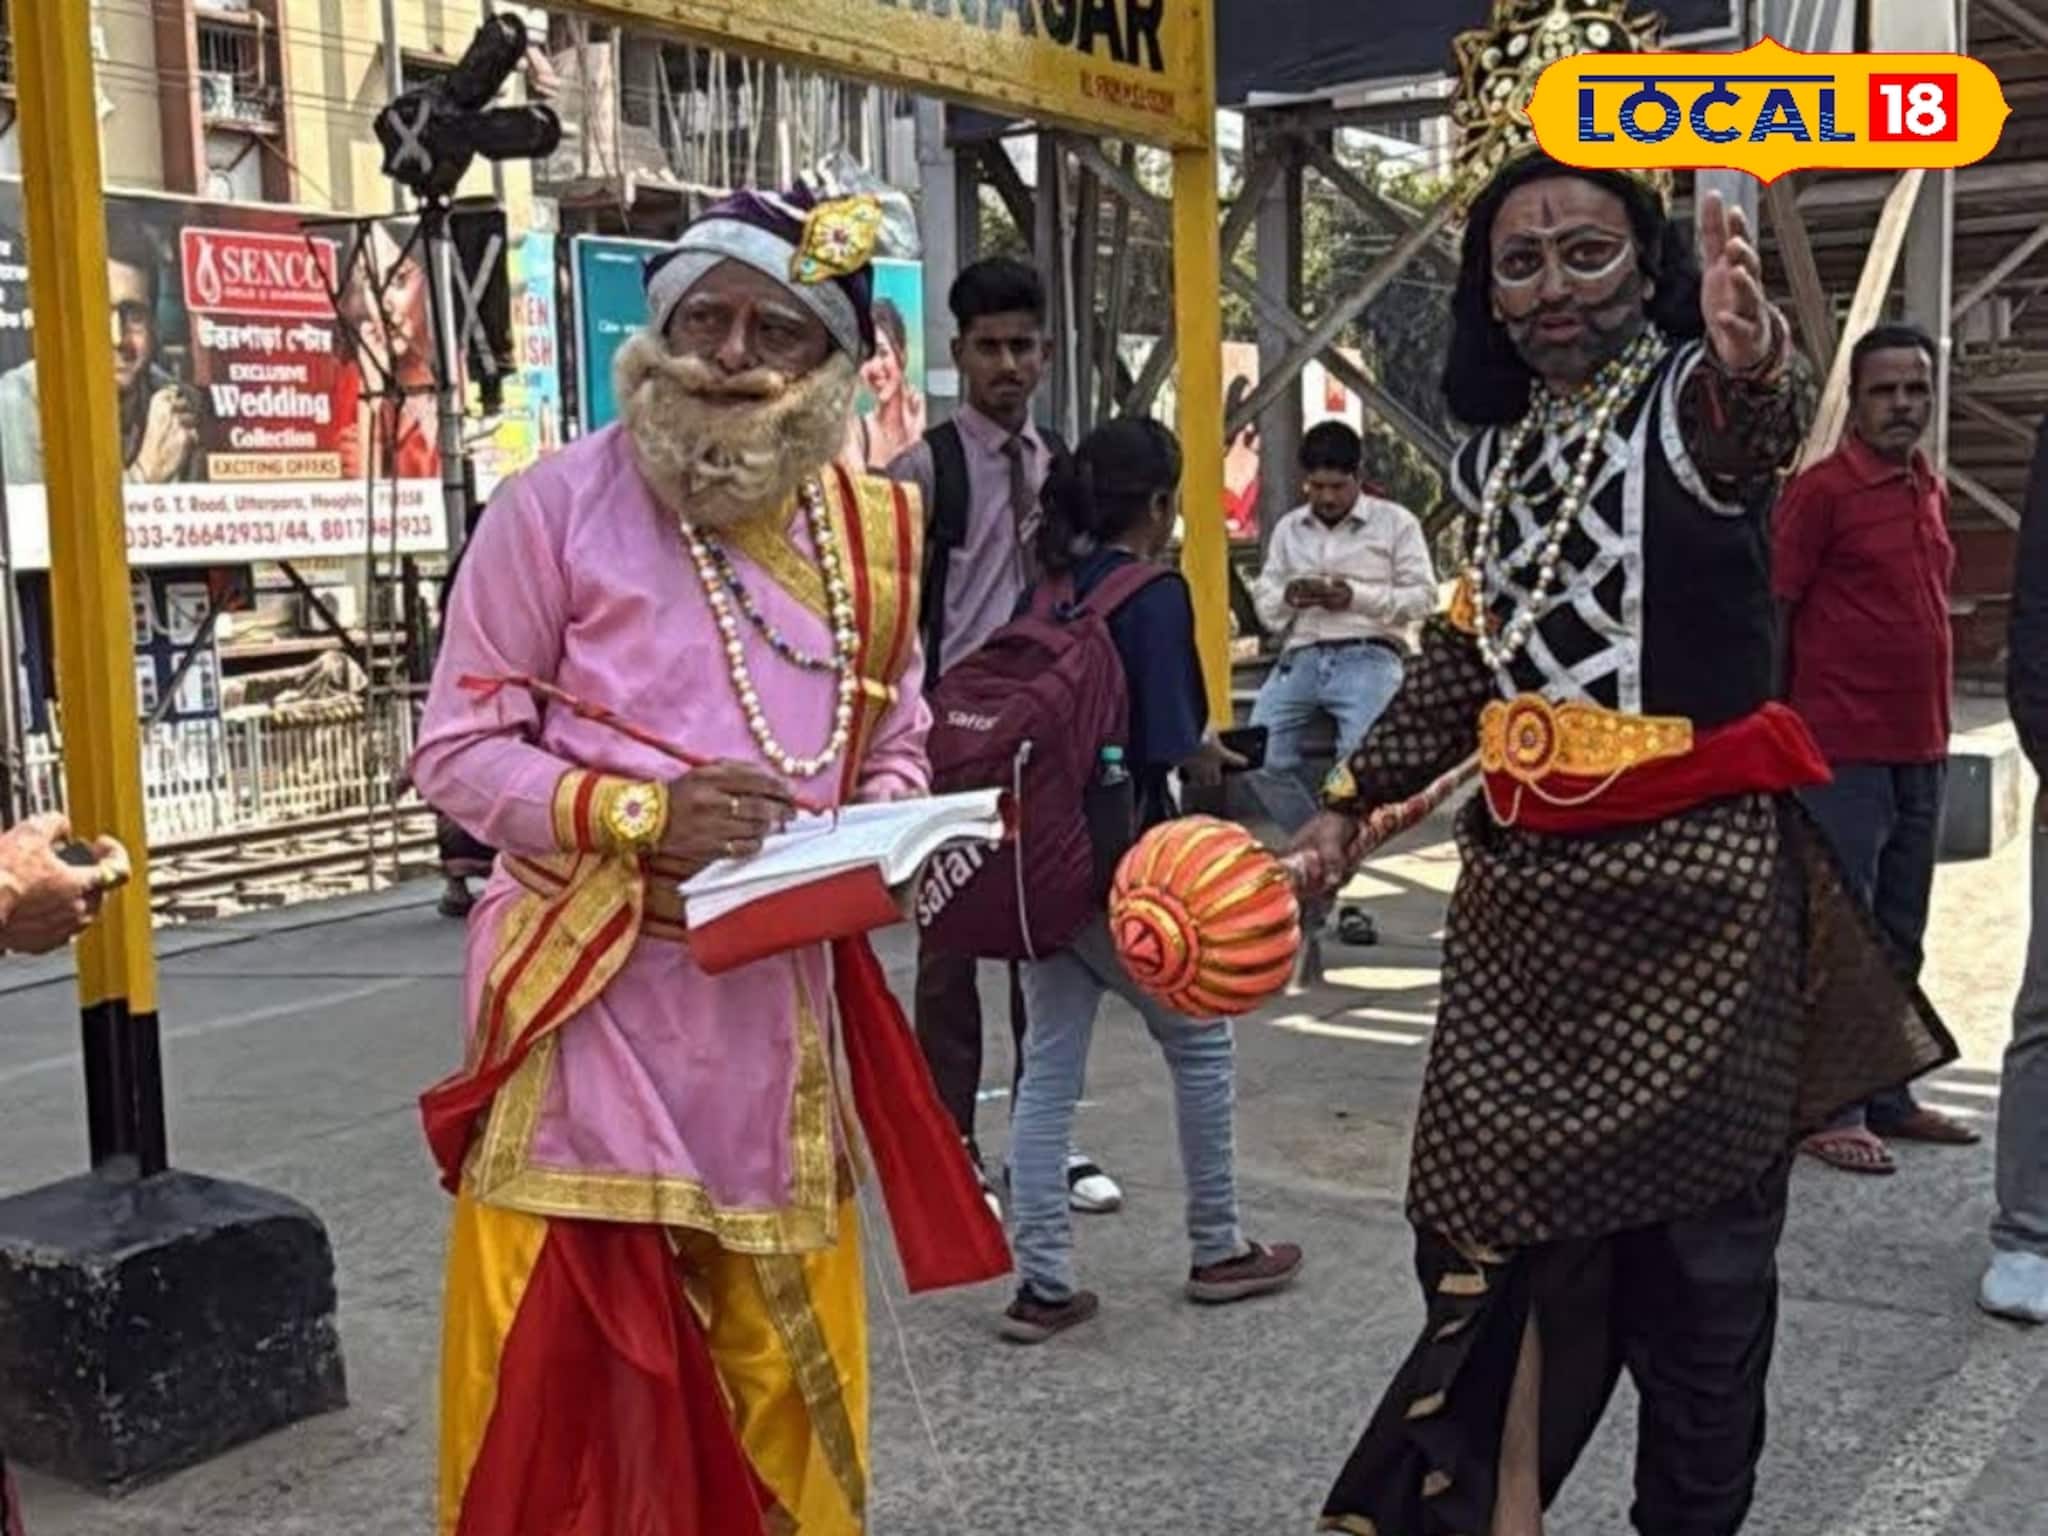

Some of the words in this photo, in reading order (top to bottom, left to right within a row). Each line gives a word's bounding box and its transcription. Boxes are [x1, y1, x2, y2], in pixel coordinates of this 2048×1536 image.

[229, 362, 308, 383] EXCLUSIVE
[210, 383, 331, 424] Wedding
[230, 426, 317, 449] Collection
[214, 458, 284, 475] EXCITING
[286, 457, 338, 474] OFFERS
